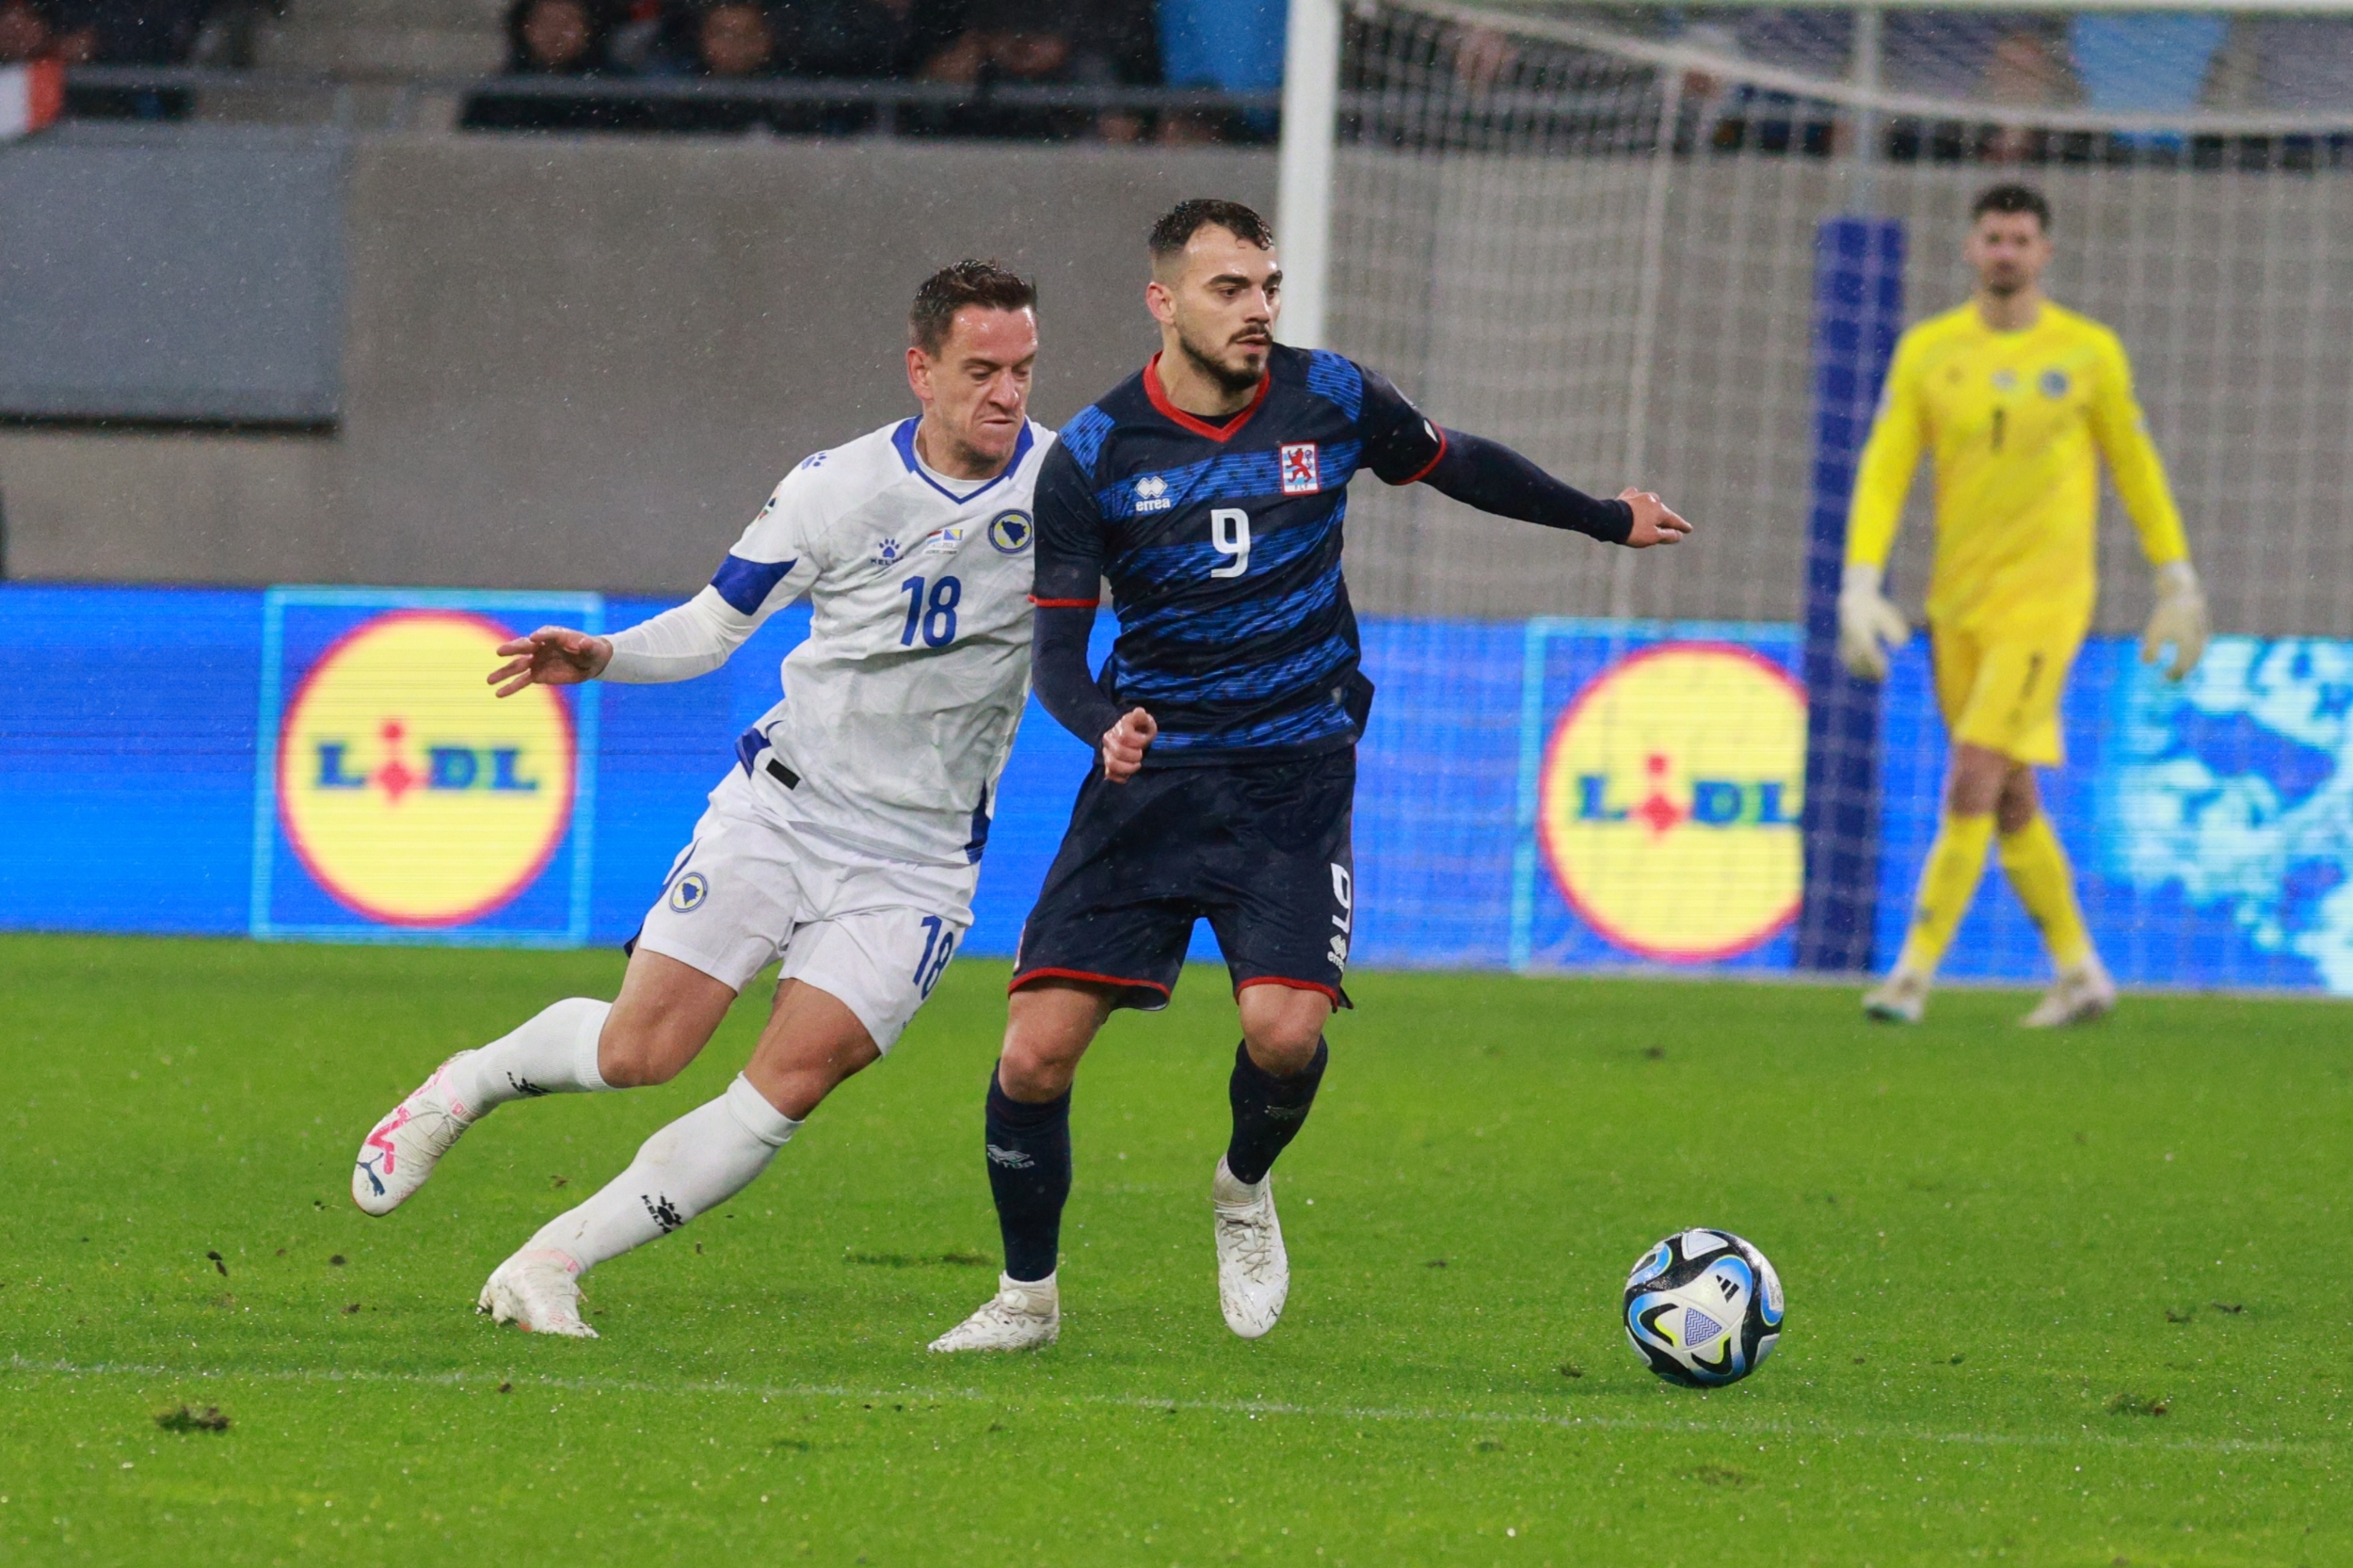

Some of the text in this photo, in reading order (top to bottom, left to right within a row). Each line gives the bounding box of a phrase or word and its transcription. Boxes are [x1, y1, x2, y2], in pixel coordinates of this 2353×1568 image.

[1135, 498, 1171, 511] errea
[1210, 508, 1251, 578] 9
[901, 575, 961, 648] 18
[1331, 863, 1351, 934] 9
[913, 915, 953, 1000] 18
